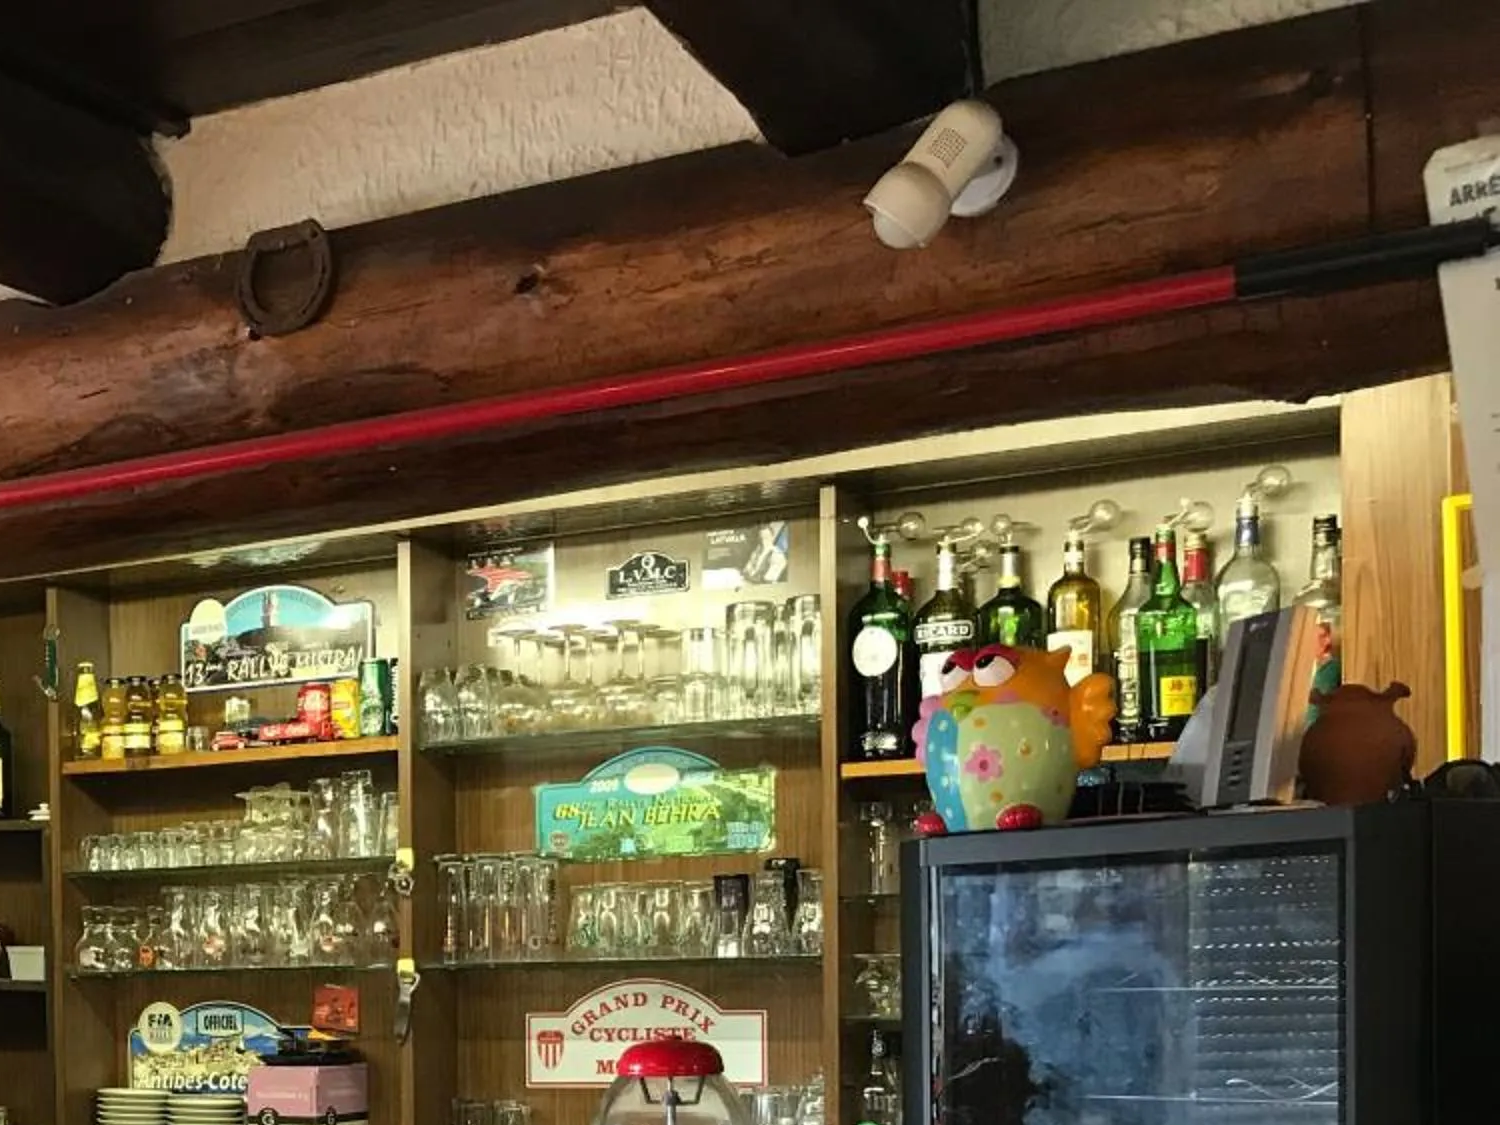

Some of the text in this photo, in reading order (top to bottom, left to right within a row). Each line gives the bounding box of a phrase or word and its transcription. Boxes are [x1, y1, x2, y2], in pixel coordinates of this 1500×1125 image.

[571, 992, 715, 1036] GRAND PRIX
[589, 1027, 697, 1042] CYCLISTE
